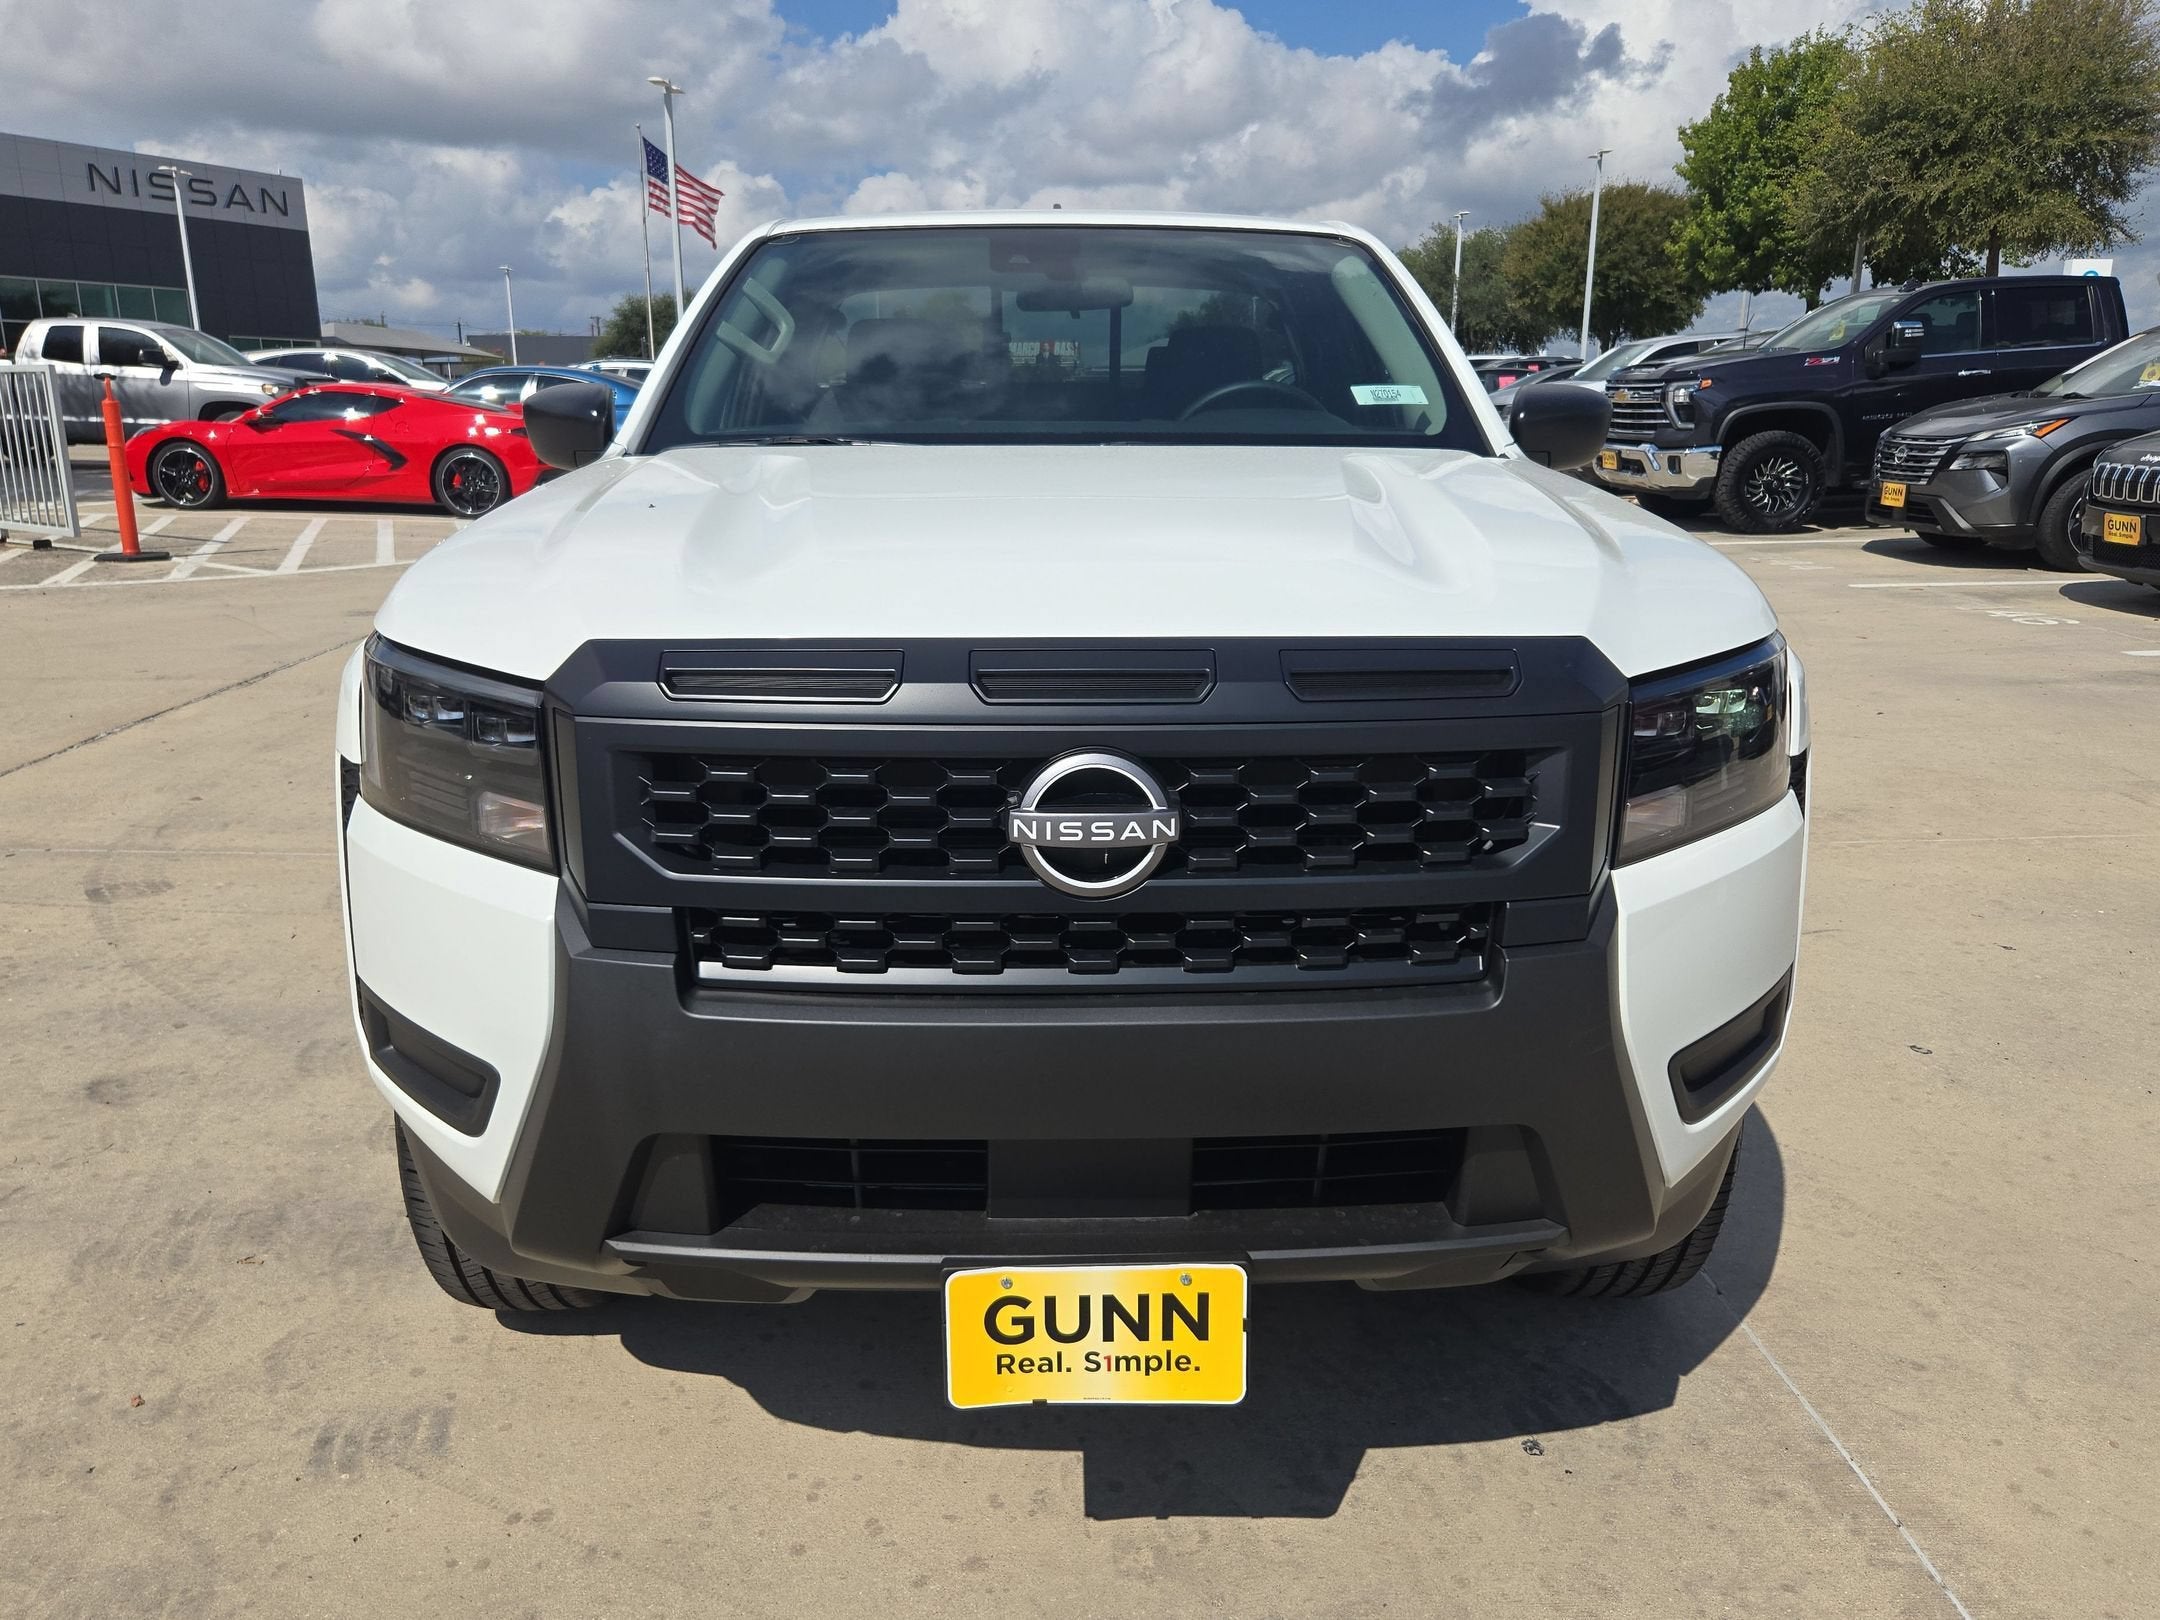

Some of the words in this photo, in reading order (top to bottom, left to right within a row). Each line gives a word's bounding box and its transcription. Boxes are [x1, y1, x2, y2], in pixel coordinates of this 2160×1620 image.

[88, 163, 288, 216] NISSAN
[2108, 519, 2137, 533] GUNN
[1013, 818, 1176, 841] NISSAN
[985, 1292, 1210, 1345] GUNN
[996, 1351, 1072, 1374] Real.
